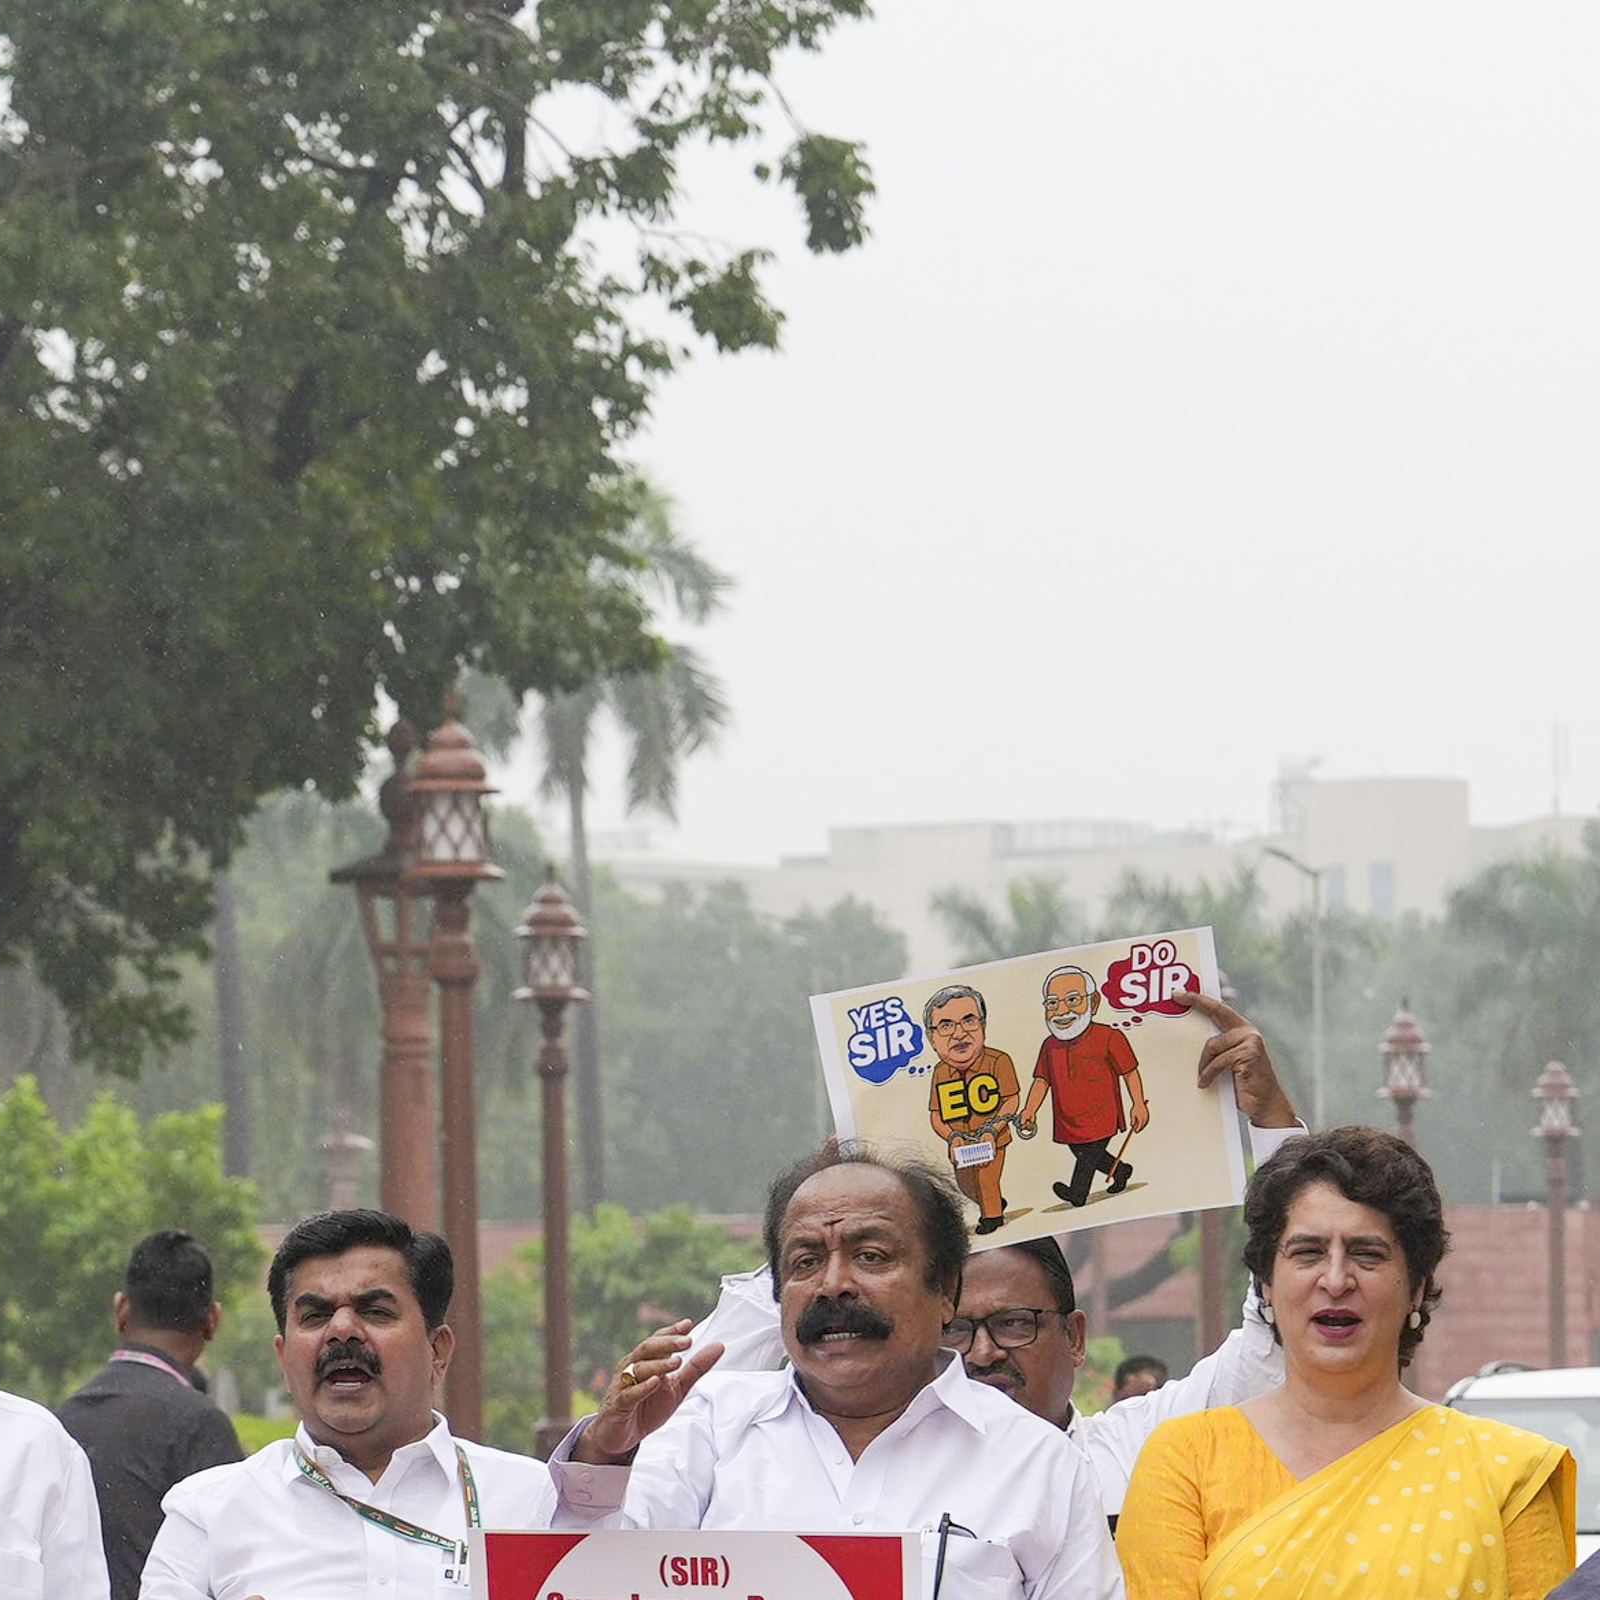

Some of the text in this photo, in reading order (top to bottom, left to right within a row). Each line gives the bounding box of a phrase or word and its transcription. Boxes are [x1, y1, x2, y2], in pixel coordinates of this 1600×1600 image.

[1131, 940, 1176, 968] DO
[1119, 963, 1191, 1006] SIR
[849, 997, 904, 1032] YES
[849, 1022, 916, 1067] SIR
[937, 1074, 1000, 1122] EC
[659, 1554, 731, 1589] (SIR)
